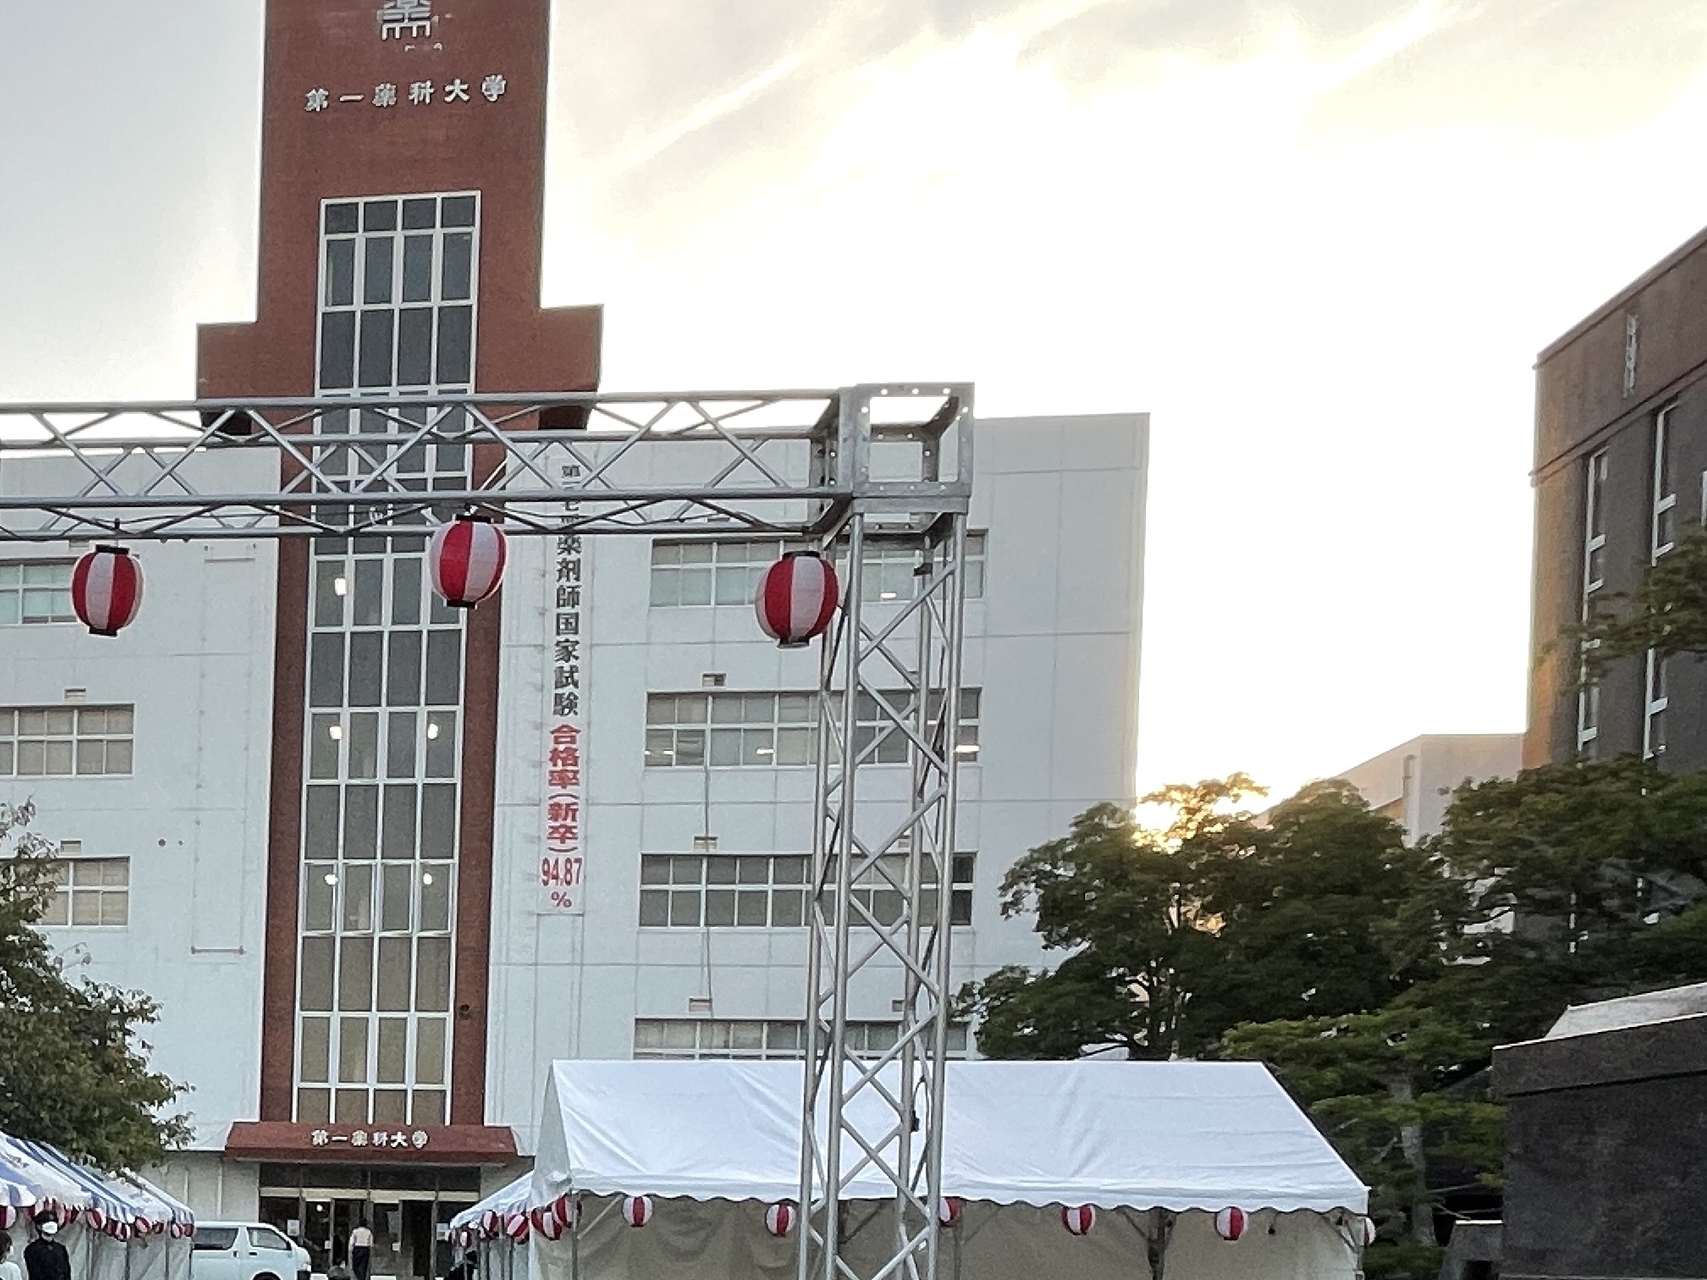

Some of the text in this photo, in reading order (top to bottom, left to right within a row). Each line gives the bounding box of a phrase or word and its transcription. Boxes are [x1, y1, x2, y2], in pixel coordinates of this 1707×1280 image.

[304, 73, 507, 112] 第一薬科大学
[311, 1129, 429, 1150] 第一薬科大学
